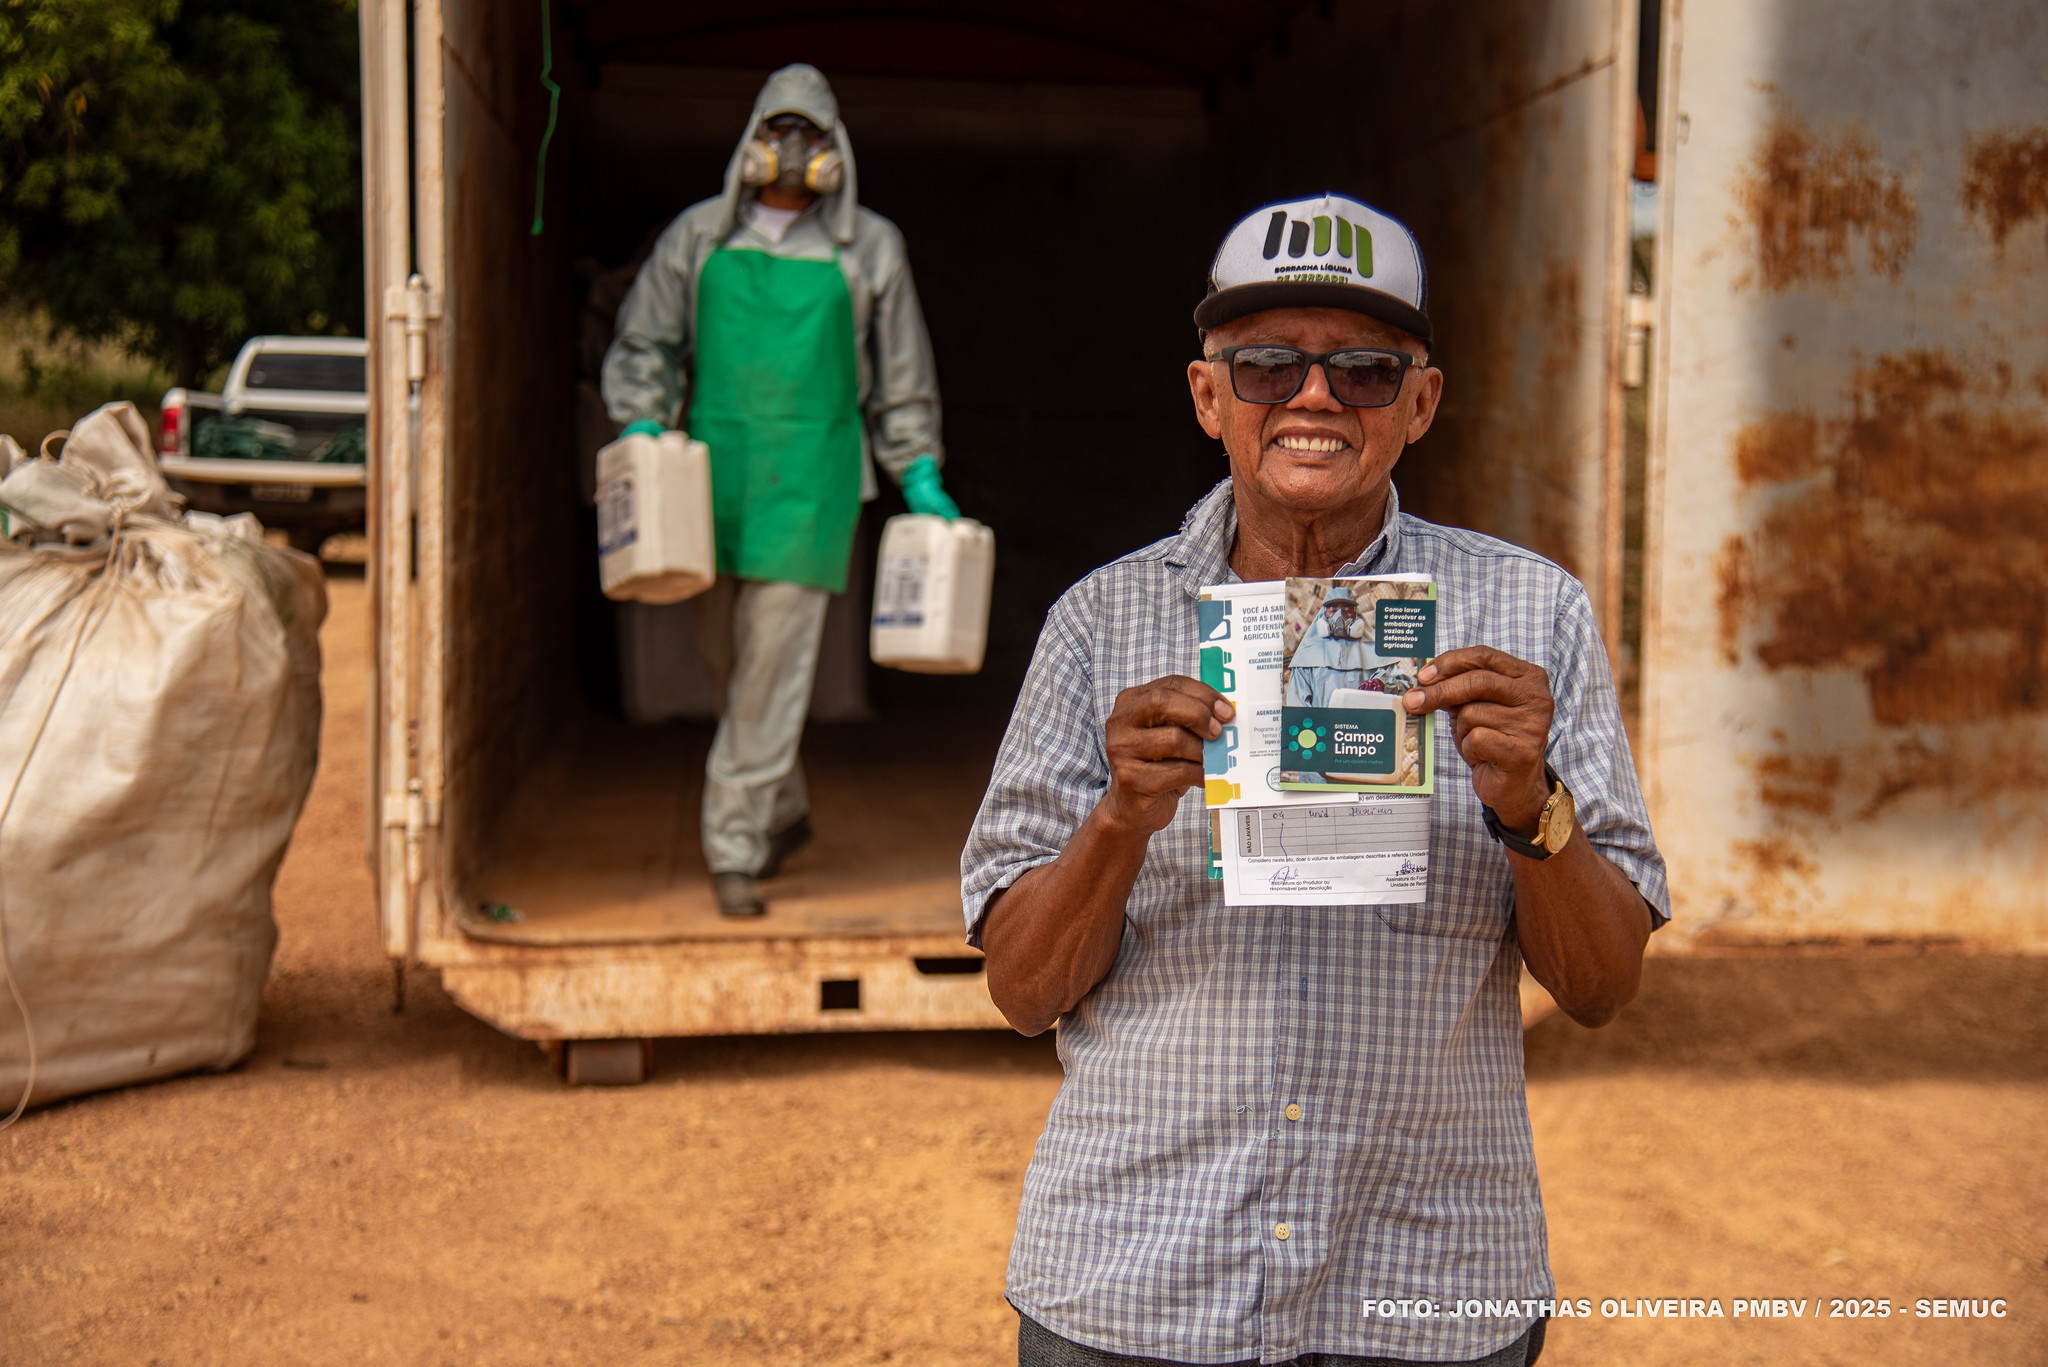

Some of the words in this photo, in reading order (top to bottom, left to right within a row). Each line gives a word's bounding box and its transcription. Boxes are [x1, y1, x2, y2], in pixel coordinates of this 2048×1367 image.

[1275, 264, 1318, 273] BORRACHA
[1320, 263, 1352, 274] LÍQUIDA
[1294, 274, 1348, 283] VERDADE!
[1254, 622, 1285, 631] DEFENSÍV
[1244, 632, 1280, 640] AGRÍCOLAS
[1334, 731, 1384, 744] Campo
[1335, 743, 1376, 757] Limpo
